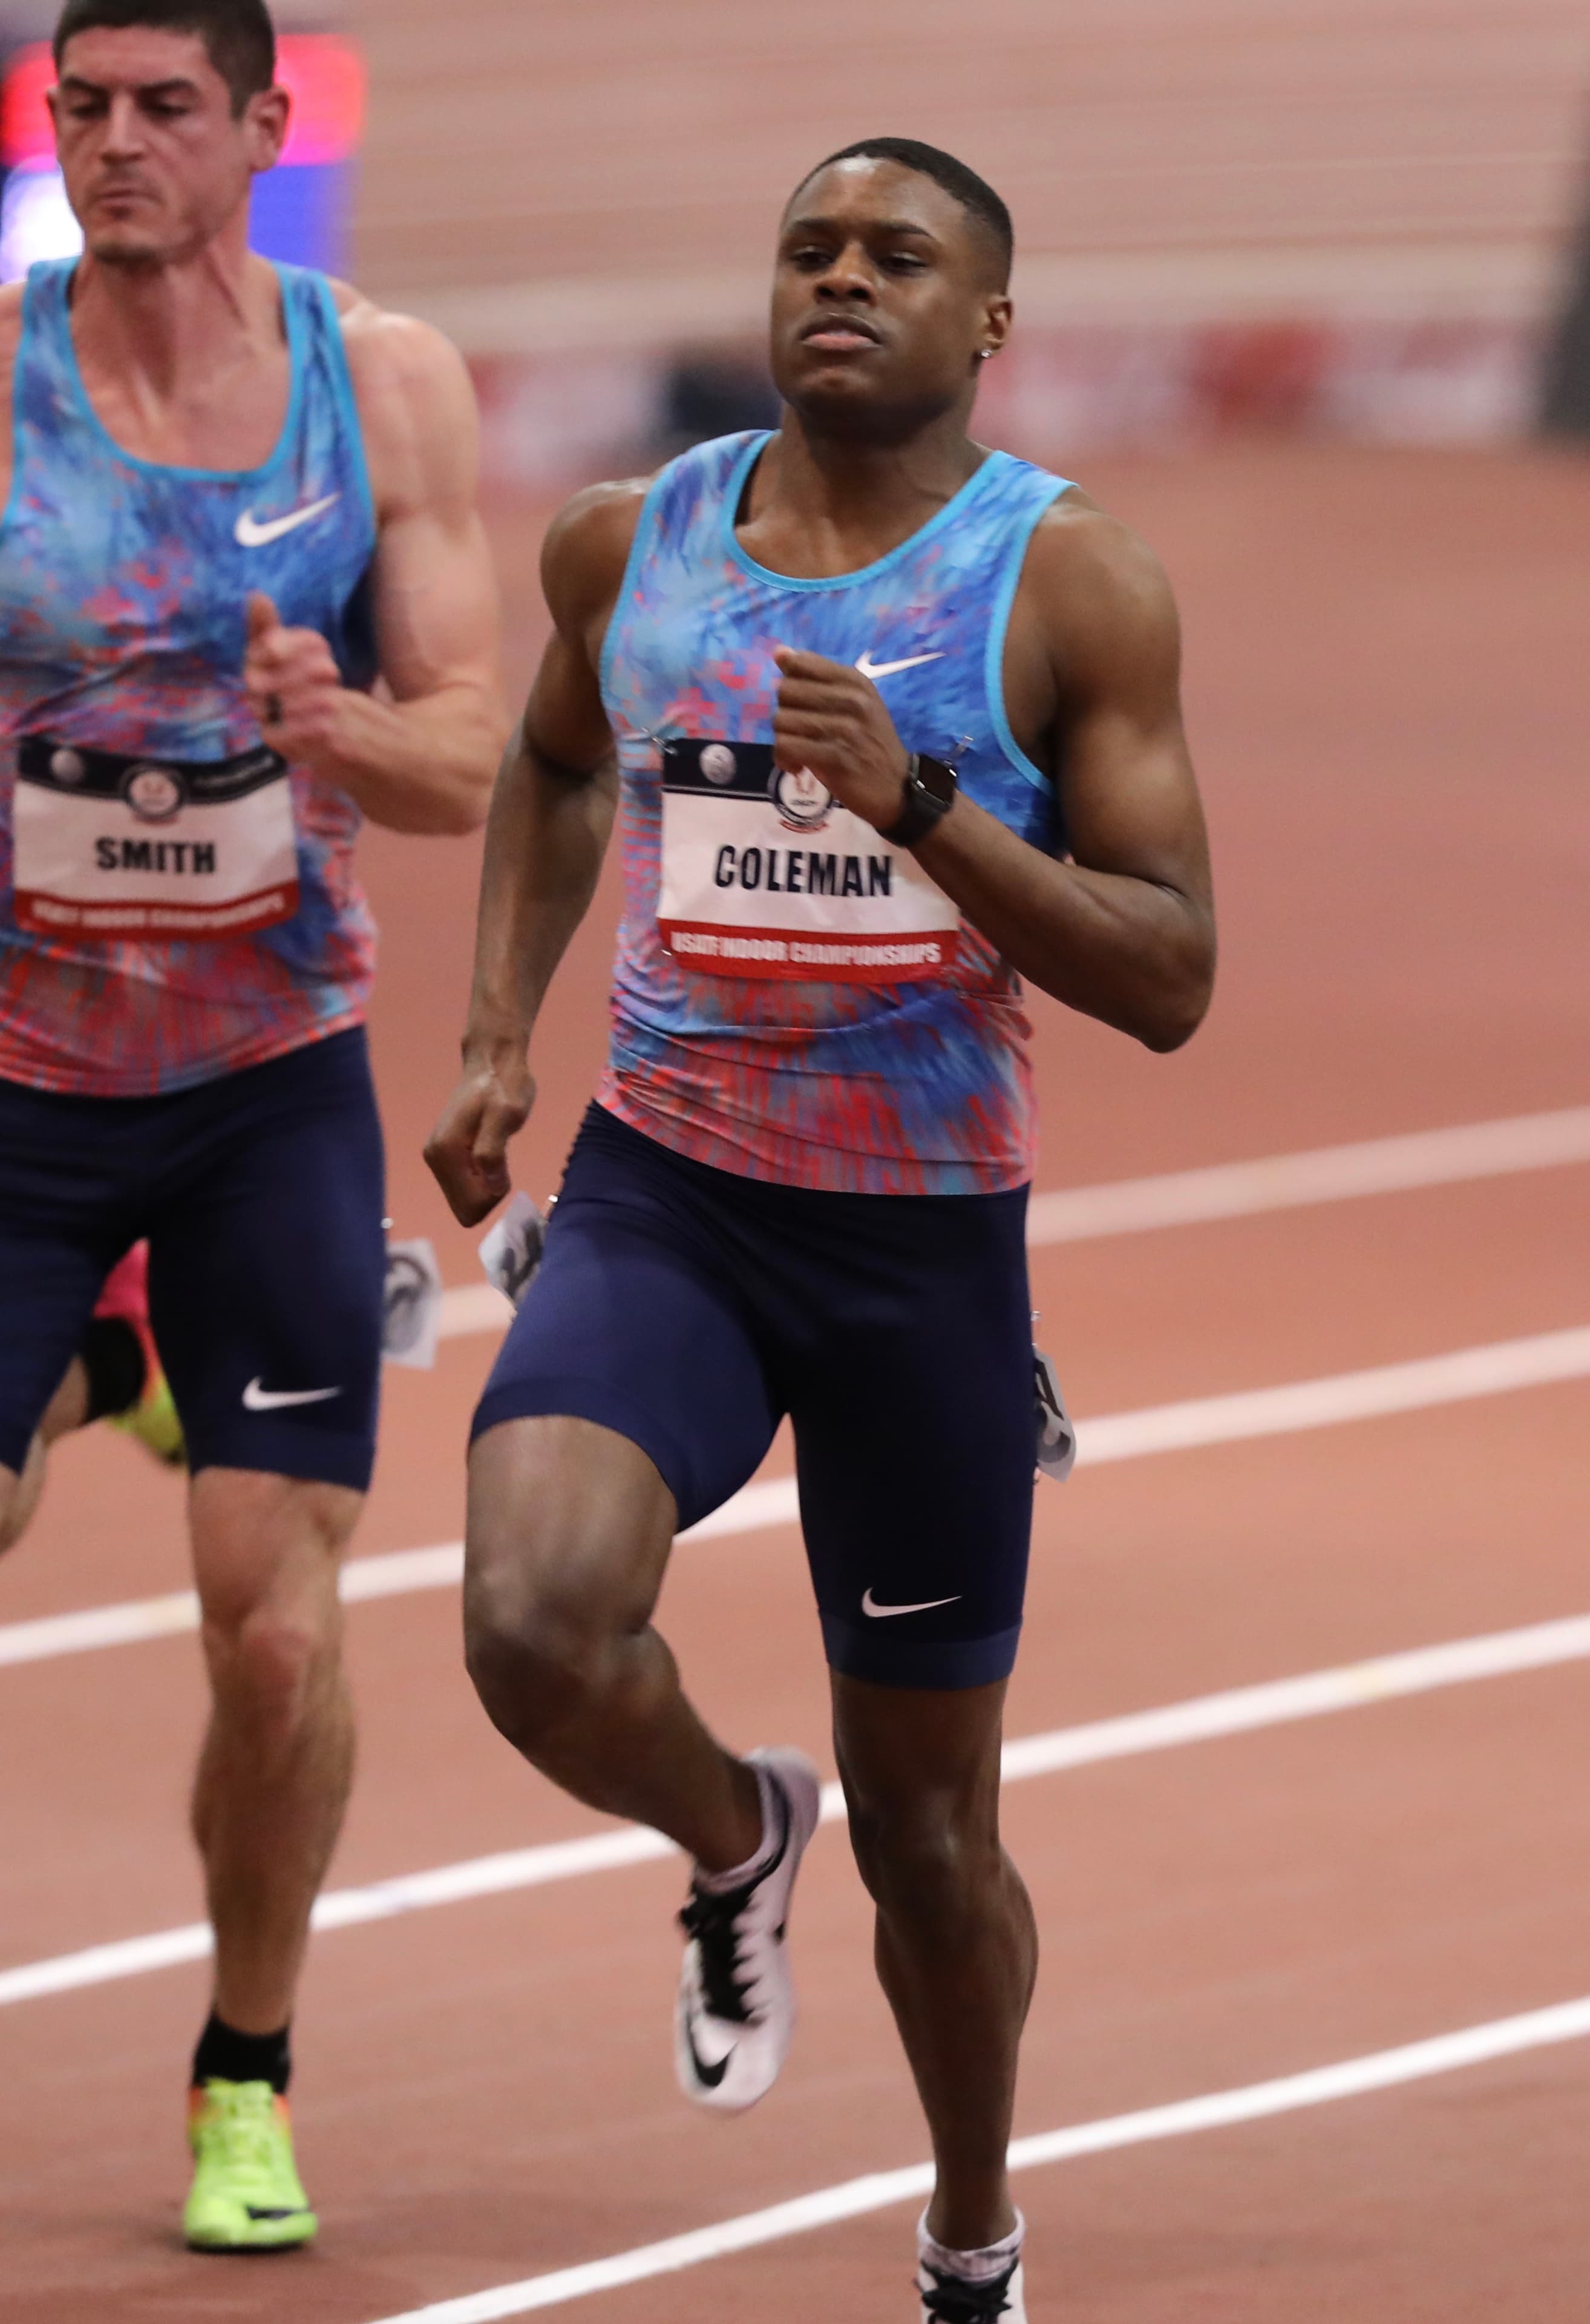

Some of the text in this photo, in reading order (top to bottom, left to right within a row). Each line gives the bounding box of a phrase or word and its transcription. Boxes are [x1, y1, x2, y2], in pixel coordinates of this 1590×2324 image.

[95, 837, 217, 874] SMITH
[715, 845, 893, 897] COLEMAN
[788, 941, 941, 966] CHAMPIONSHIPS
